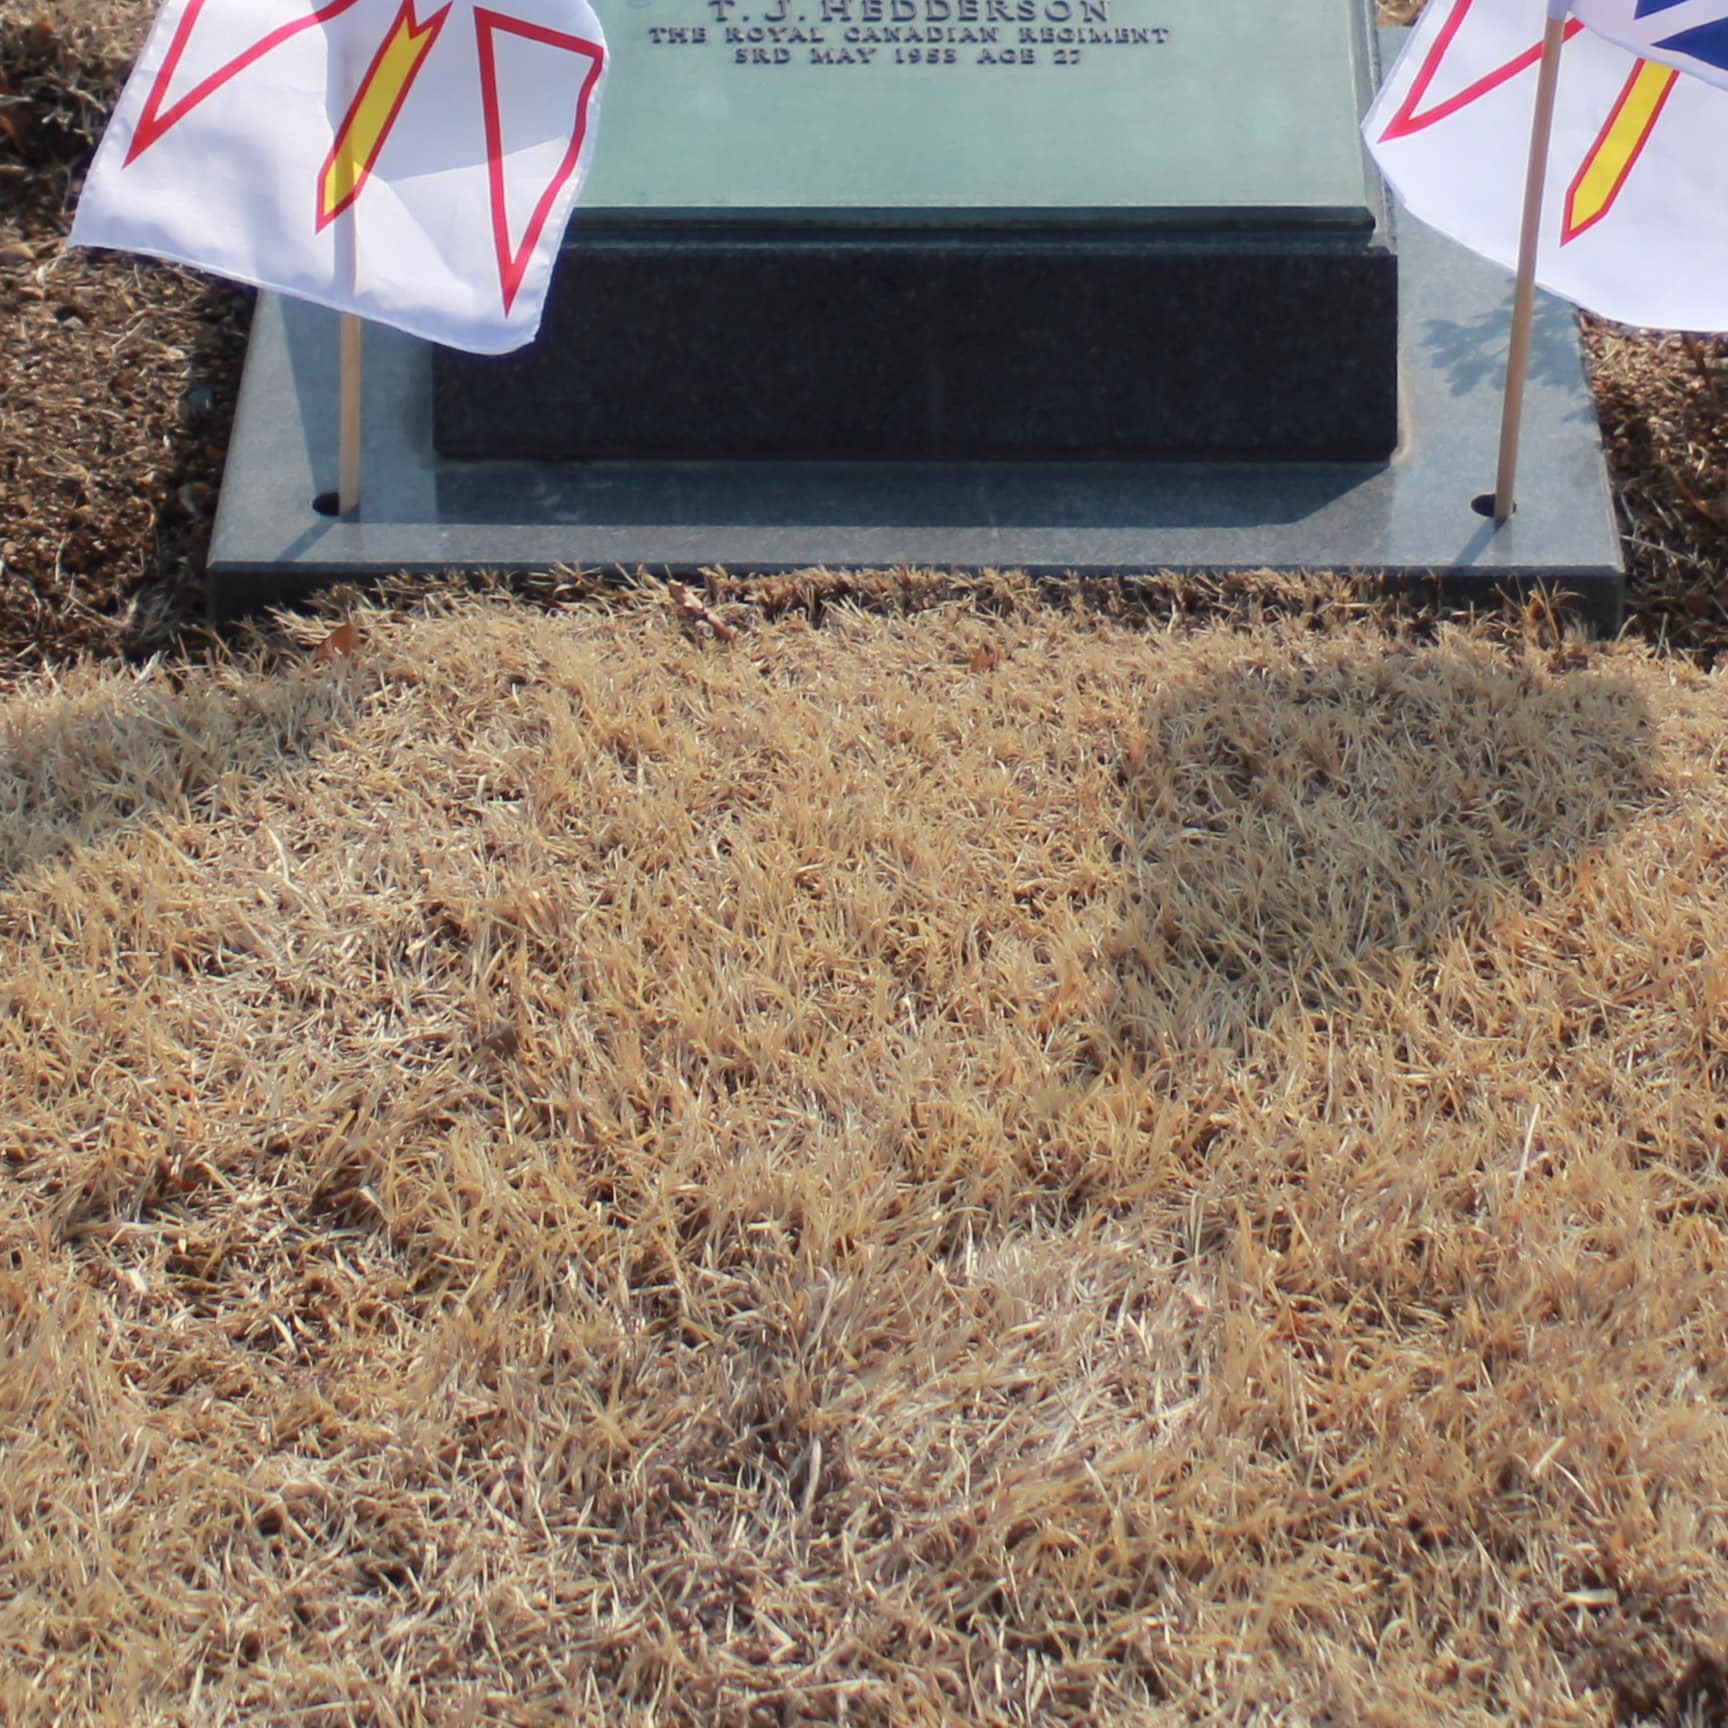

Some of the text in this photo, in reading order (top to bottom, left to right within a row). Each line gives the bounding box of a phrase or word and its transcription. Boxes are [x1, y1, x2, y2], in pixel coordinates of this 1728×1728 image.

[648, 26, 1170, 45] THE ROYAL CANADIAN REGIMENT
[809, 47, 878, 65] MAY
[975, 47, 1036, 65] AGE
